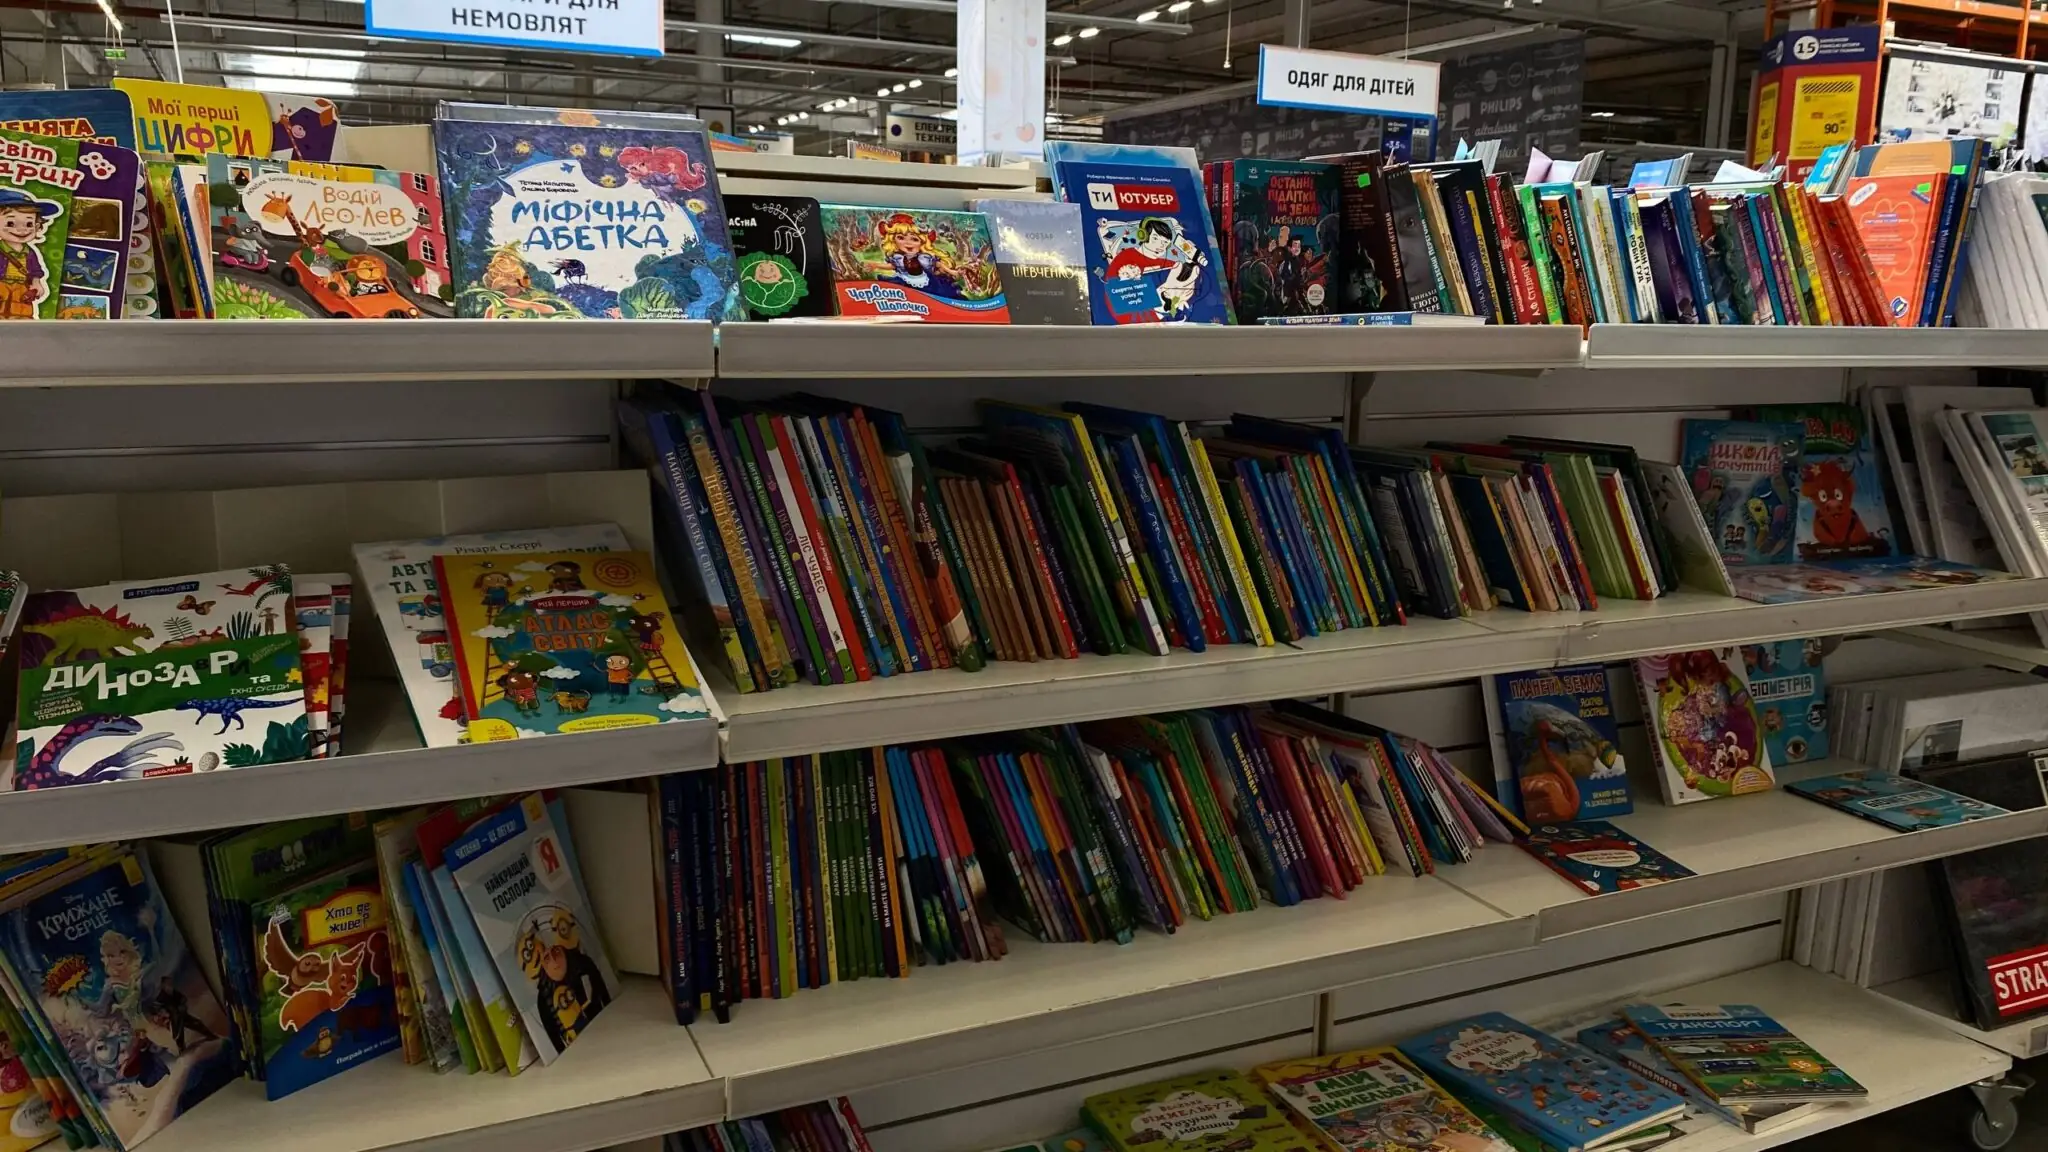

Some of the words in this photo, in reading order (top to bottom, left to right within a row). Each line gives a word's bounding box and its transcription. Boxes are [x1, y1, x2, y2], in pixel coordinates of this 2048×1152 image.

[451, 8, 588, 36] НЕМОВЛЯТ
[1797, 42, 1816, 54] 15
[1287, 69, 1330, 89] ОДЯГ
[1333, 73, 1365, 92] ДЛЯ
[1369, 75, 1415, 97] ДІТЕЙ
[147, 97, 182, 116] Мої
[187, 103, 240, 122] перші
[1480, 97, 1523, 115] PHILIPS
[0, 117, 95, 138] ЕНЯТА
[138, 117, 255, 156] ЦИФРИ
[1824, 123, 1839, 134] 90
[0, 138, 55, 163] віт
[0, 161, 83, 188] арин
[1092, 191, 1113, 204] ТИ
[1120, 191, 1174, 206] ЮТУБЕР
[511, 200, 666, 223] МІФІЧНА
[523, 224, 670, 251] АБЕТКА
[1627, 234, 1642, 264] РОБІН
[1634, 234, 1650, 264] РОБІН
[1012, 265, 1074, 279] ШЕВЧЕНКО
[1517, 262, 1538, 301] СТЕДМЕН
[1634, 263, 1646, 282] ГУД
[1641, 264, 1653, 283] ГУД
[848, 284, 906, 302] Червона
[1413, 295, 1439, 310] ГЮГО
[877, 300, 929, 315] Шапочка
[1710, 442, 1781, 461] ШКОЛА
[664, 451, 693, 510] НАЙКРАЩІ
[685, 512, 706, 551] КАЗКИ
[699, 552, 718, 587] СВІТУ
[703, 473, 728, 517] ПЕРШІ
[718, 518, 743, 562] КАЗКИ
[747, 460, 763, 489] ДИТЯЧА
[776, 544, 792, 576] ПЛАНЕТИ
[787, 576, 801, 600] ЗЕМЛЯ
[455, 543, 496, 555] Річард
[499, 541, 543, 552] Скеррі
[729, 509, 747, 545] КАЗКИ
[742, 547, 759, 579] СВІТУ
[392, 561, 432, 578] АВТ
[797, 533, 811, 553] ЛІС
[805, 555, 826, 594] ЧУДЕС
[389, 580, 420, 594] ТА
[538, 599, 553, 608] МІЙ
[555, 597, 590, 608] ПЕРШИЙ
[524, 612, 613, 633] АТЛАС
[533, 631, 608, 651] СВІТУ
[230, 686, 255, 696] ЇХНІ
[255, 683, 290, 693] СУСІДИ
[249, 674, 271, 684] та
[1509, 677, 1563, 700] ПЛАНЕТА
[1564, 673, 1606, 695] ЗЕМЛЯ
[483, 852, 531, 896] НАЙКРАЩИЙ
[875, 856, 886, 880] ЗНАТИ
[492, 872, 537, 913] ГОСПОДАР
[867, 870, 876, 900] ТВАРИНАМ
[37, 886, 124, 941] КРИЖАНЕ
[326, 905, 353, 921] Хто
[356, 902, 372, 917] де
[880, 891, 890, 916] МАЄТЕ
[64, 909, 113, 942] СЕРЦЕ
[328, 912, 371, 935] живе?
[1656, 1020, 1763, 1030] ТРАНСПОРТ
[1314, 1070, 1377, 1093] МІЙ
[1307, 1081, 1426, 1116] ВІММЕЛЬБУХ
